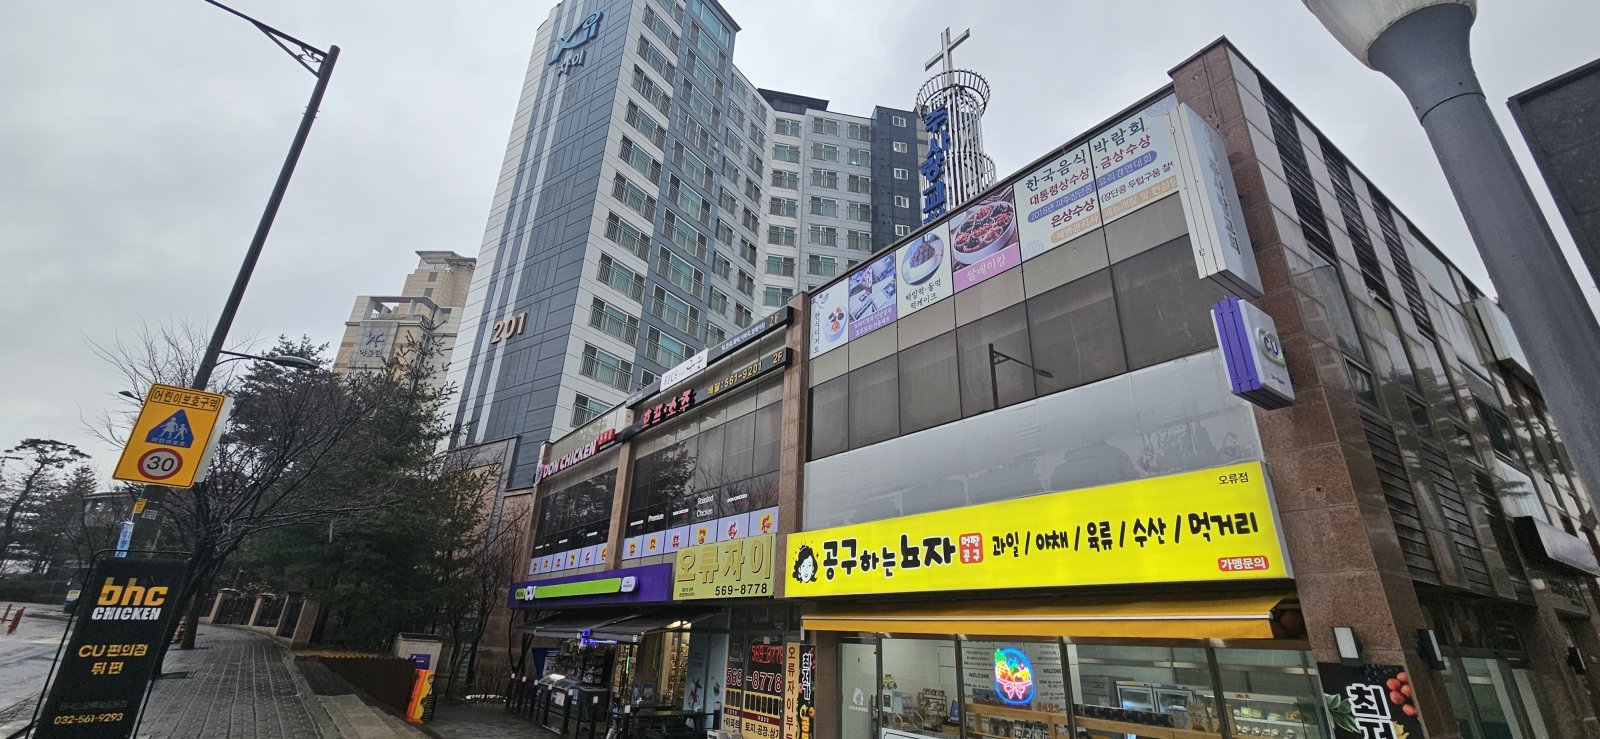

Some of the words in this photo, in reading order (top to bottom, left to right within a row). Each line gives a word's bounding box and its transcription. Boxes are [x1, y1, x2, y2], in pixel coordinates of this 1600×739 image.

[1026, 149, 1086, 192] 한국음식
[1093, 117, 1145, 153] 박람회
[1029, 167, 1090, 205] 대통령상수상
[1100, 134, 1151, 169] 금상수상
[1030, 203, 1055, 221] 2018년
[1099, 153, 1152, 186] 요리경연대회
[1051, 197, 1095, 228] 은상수상
[966, 256, 1006, 281] 쌀베이킹
[490, 312, 527, 344] 201
[769, 312, 780, 327] 2F
[1263, 335, 1279, 356] CU
[772, 351, 783, 364] 2F
[153, 390, 219, 410] 어린이보호구역
[147, 456, 175, 472] 30
[542, 457, 560, 478] DON
[558, 439, 597, 469] CHICKEN
[1218, 472, 1249, 485] 오류점
[992, 531, 1019, 557] 과일
[1036, 529, 1069, 551] 야채
[1086, 521, 1113, 552] 육류
[1132, 517, 1166, 547] 수산
[1188, 511, 1259, 542] 먹거리
[676, 535, 772, 584] 오류자이
[963, 549, 980, 562] 공구
[1221, 557, 1265, 571] 가맹문의
[97, 576, 168, 606] bhc
[715, 583, 768, 596] 569-8778
[91, 607, 162, 620] CHICKEN
[78, 645, 105, 658] CU
[106, 644, 149, 657] 편의점
[54, 713, 123, 725] 032-561-9293
